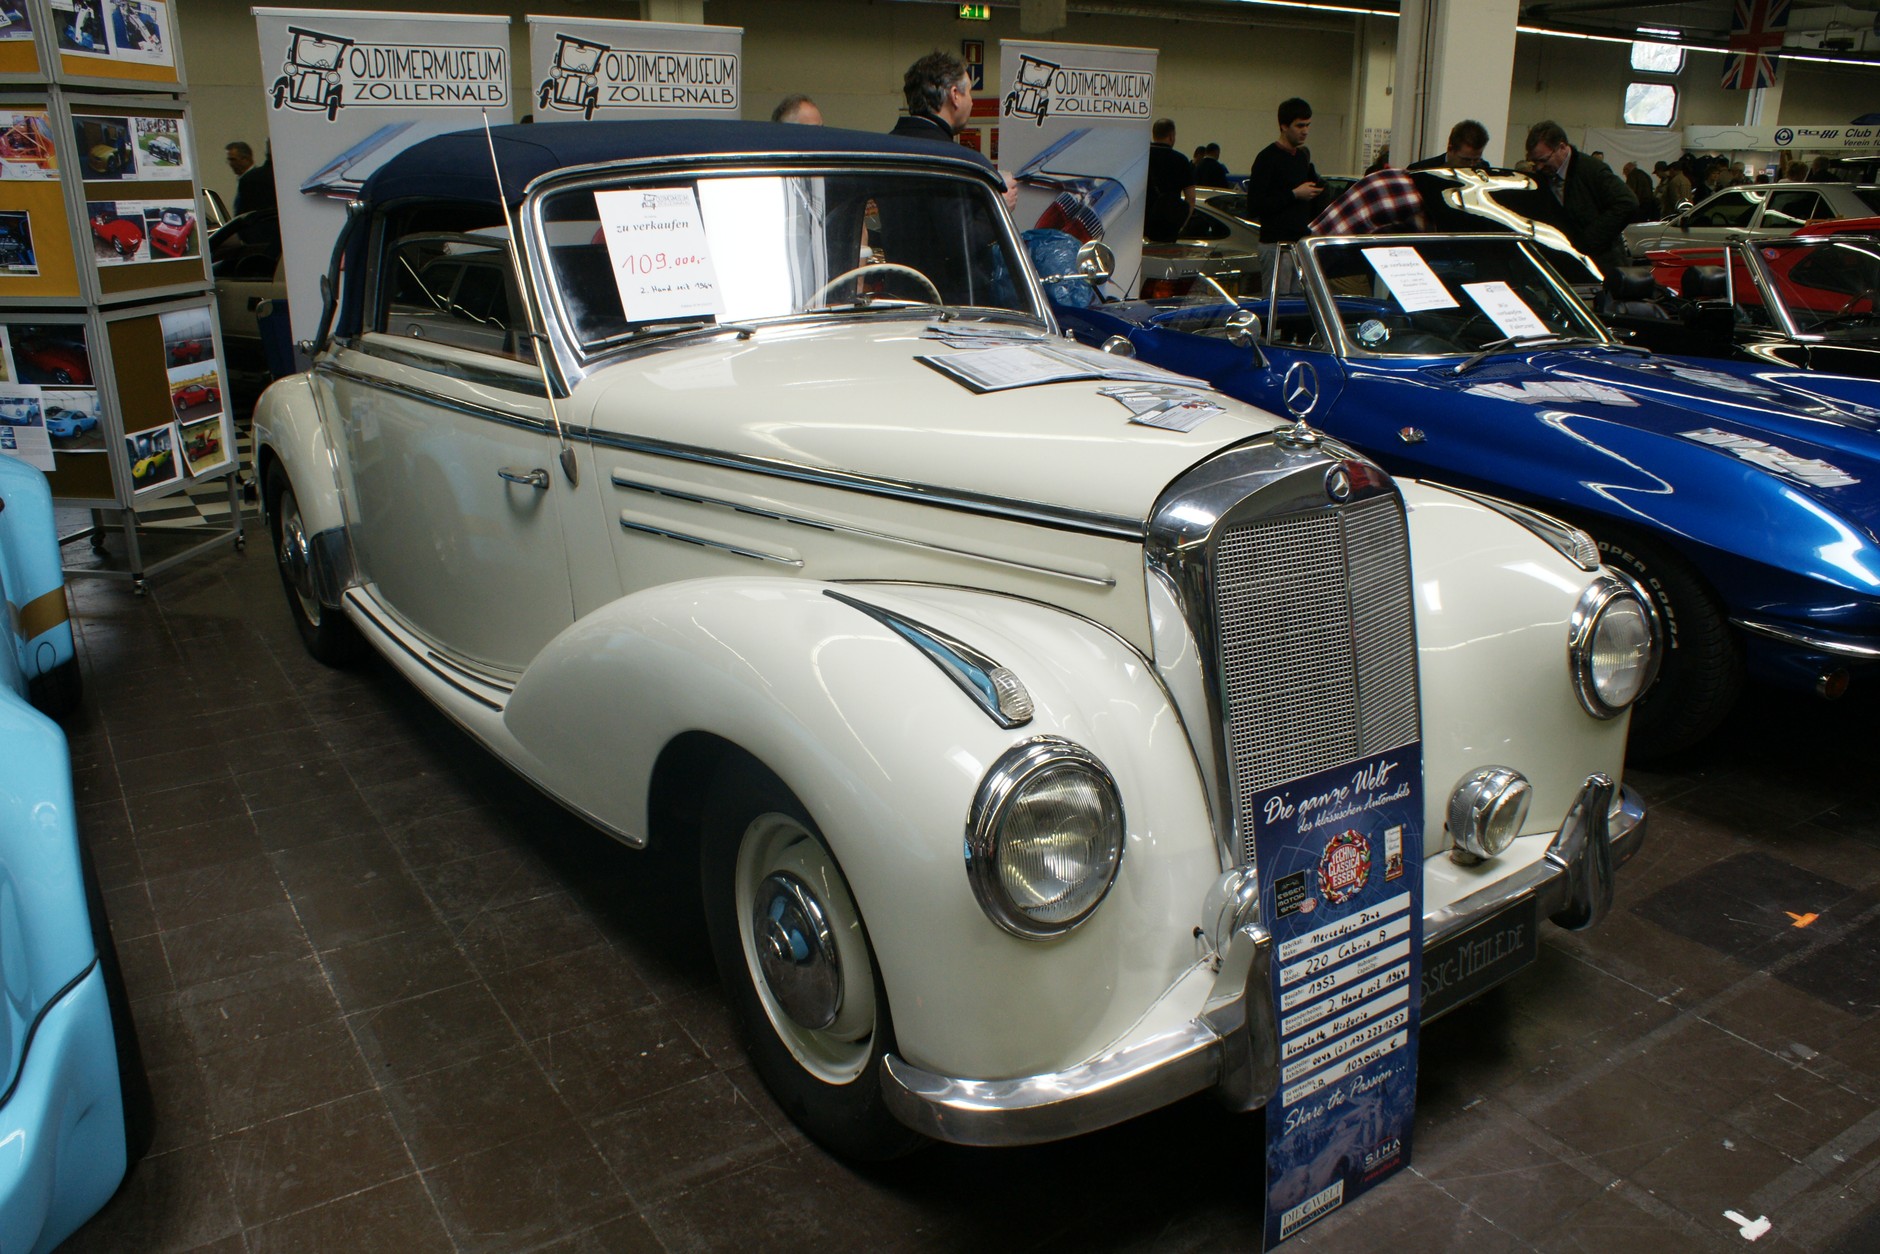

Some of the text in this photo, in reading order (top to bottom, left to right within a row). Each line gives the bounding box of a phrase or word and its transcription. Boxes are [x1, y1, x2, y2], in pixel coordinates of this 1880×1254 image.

[350, 48, 502, 81] OLDTIMERMUSEUM
[606, 53, 735, 86] OLDTIMERMUSEUM
[354, 83, 503, 101] ZOLLERNALB
[1055, 71, 1150, 98] OLDTIMERMUSEUM
[607, 86, 734, 104] ZOLLERNALB
[1056, 98, 1149, 115] ZOLLERNALB
[1845, 128, 1872, 138] Club
[616, 219, 689, 234] zu verkaufen
[651, 284, 672, 293] Hand
[1264, 760, 1399, 825] Die ganze Welt
[1298, 817, 1313, 834] des
[1328, 852, 1360, 877] CLASSICA
[1332, 847, 1356, 864] TECHNO
[1332, 868, 1357, 888] ESSEN
[1305, 954, 1328, 976] 220
[1308, 975, 1336, 995] 1953
[1341, 988, 1364, 1006] Hand
[1285, 1104, 1326, 1136] Share
[1327, 1087, 1347, 1110] the
[1350, 1064, 1394, 1098] Passion
[1365, 1138, 1401, 1165] SIHA
